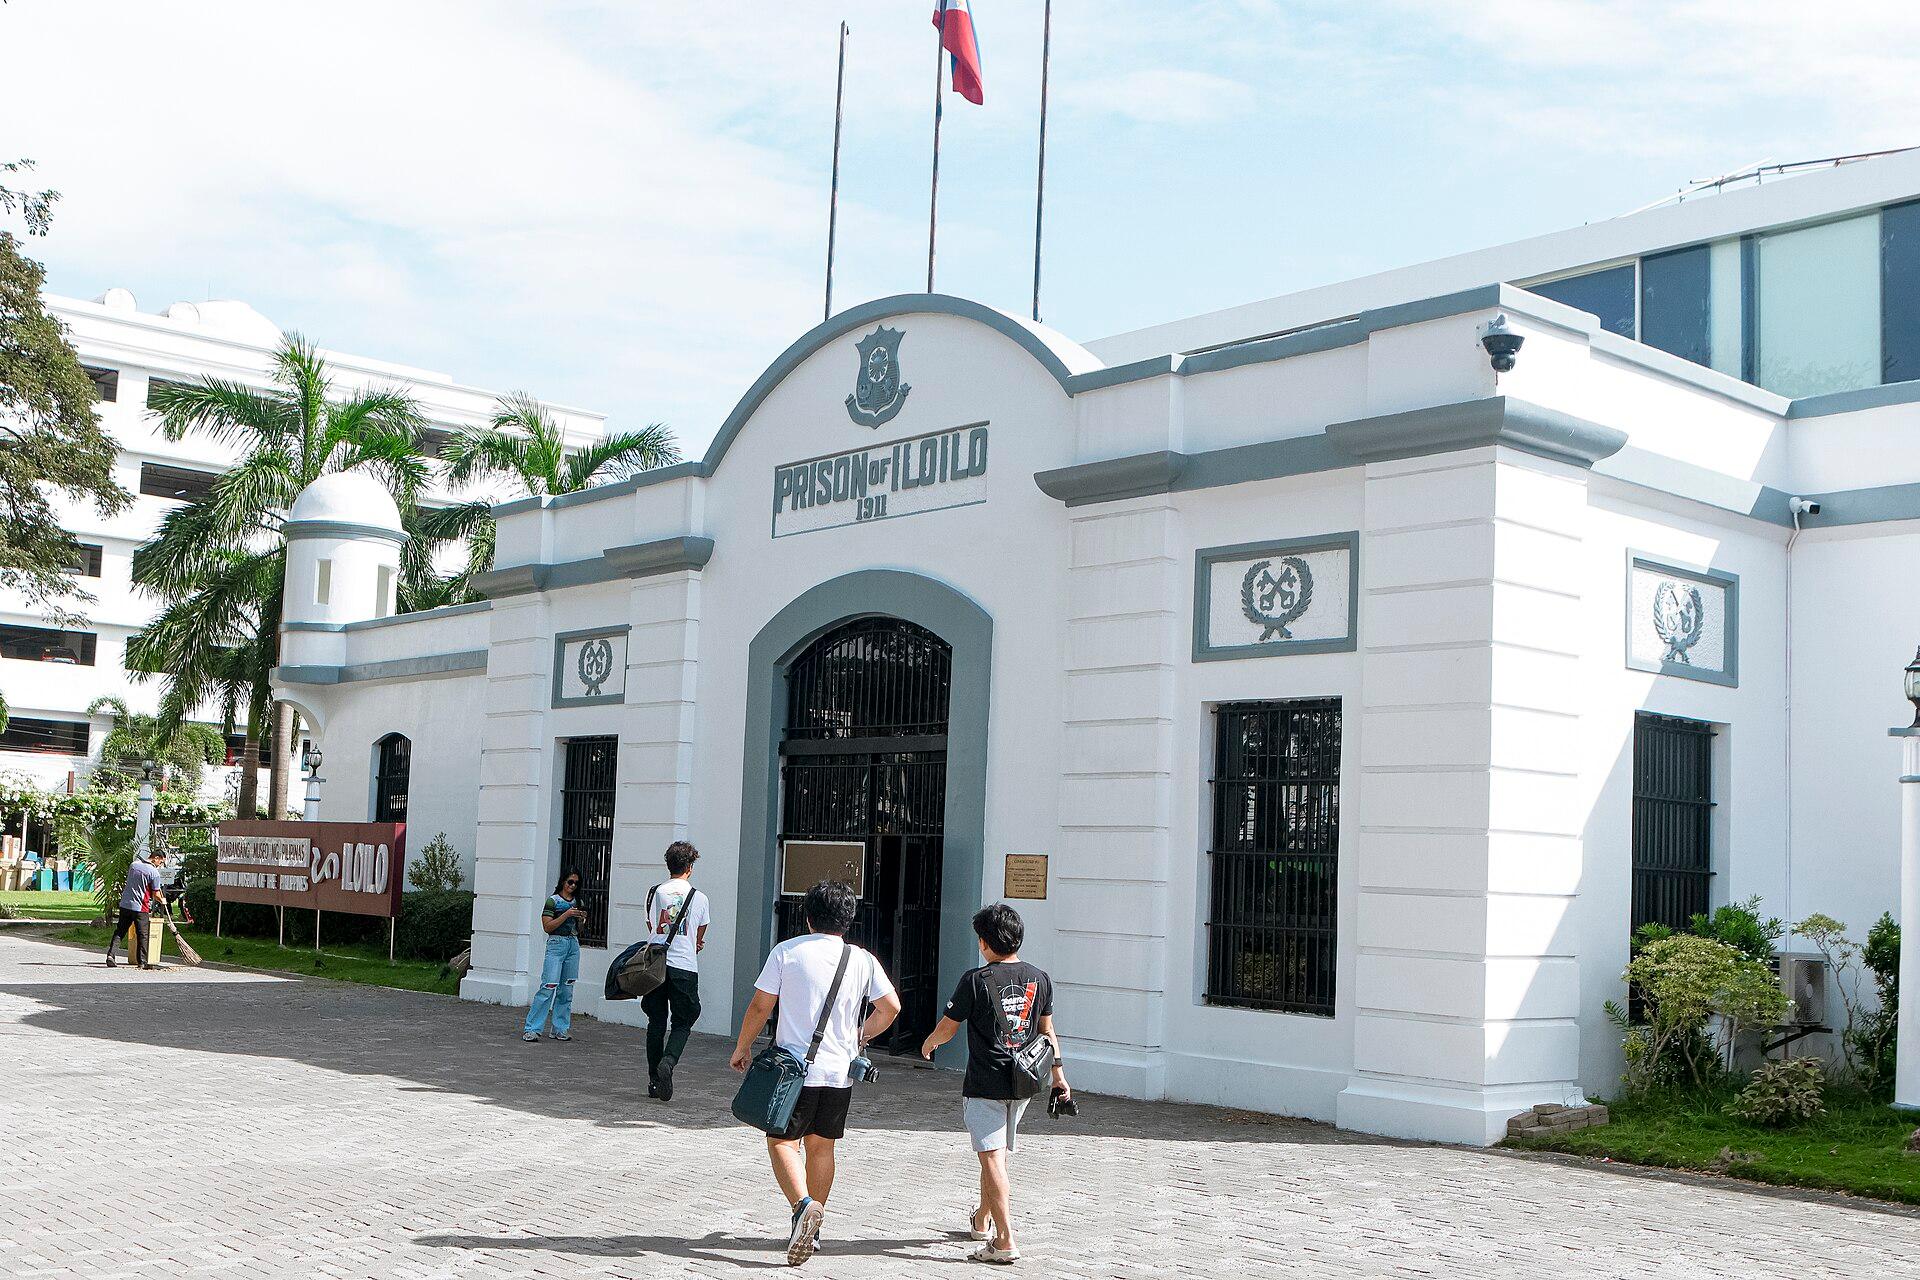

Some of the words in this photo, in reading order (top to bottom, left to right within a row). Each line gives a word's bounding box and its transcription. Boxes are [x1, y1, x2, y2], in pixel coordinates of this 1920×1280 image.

[775, 451, 869, 513] PRISON
[868, 458, 891, 486] OF
[890, 427, 988, 492] ILOILO
[855, 494, 887, 521] 1911
[252, 842, 270, 860] MUSEO
[341, 842, 389, 895] ILOILO
